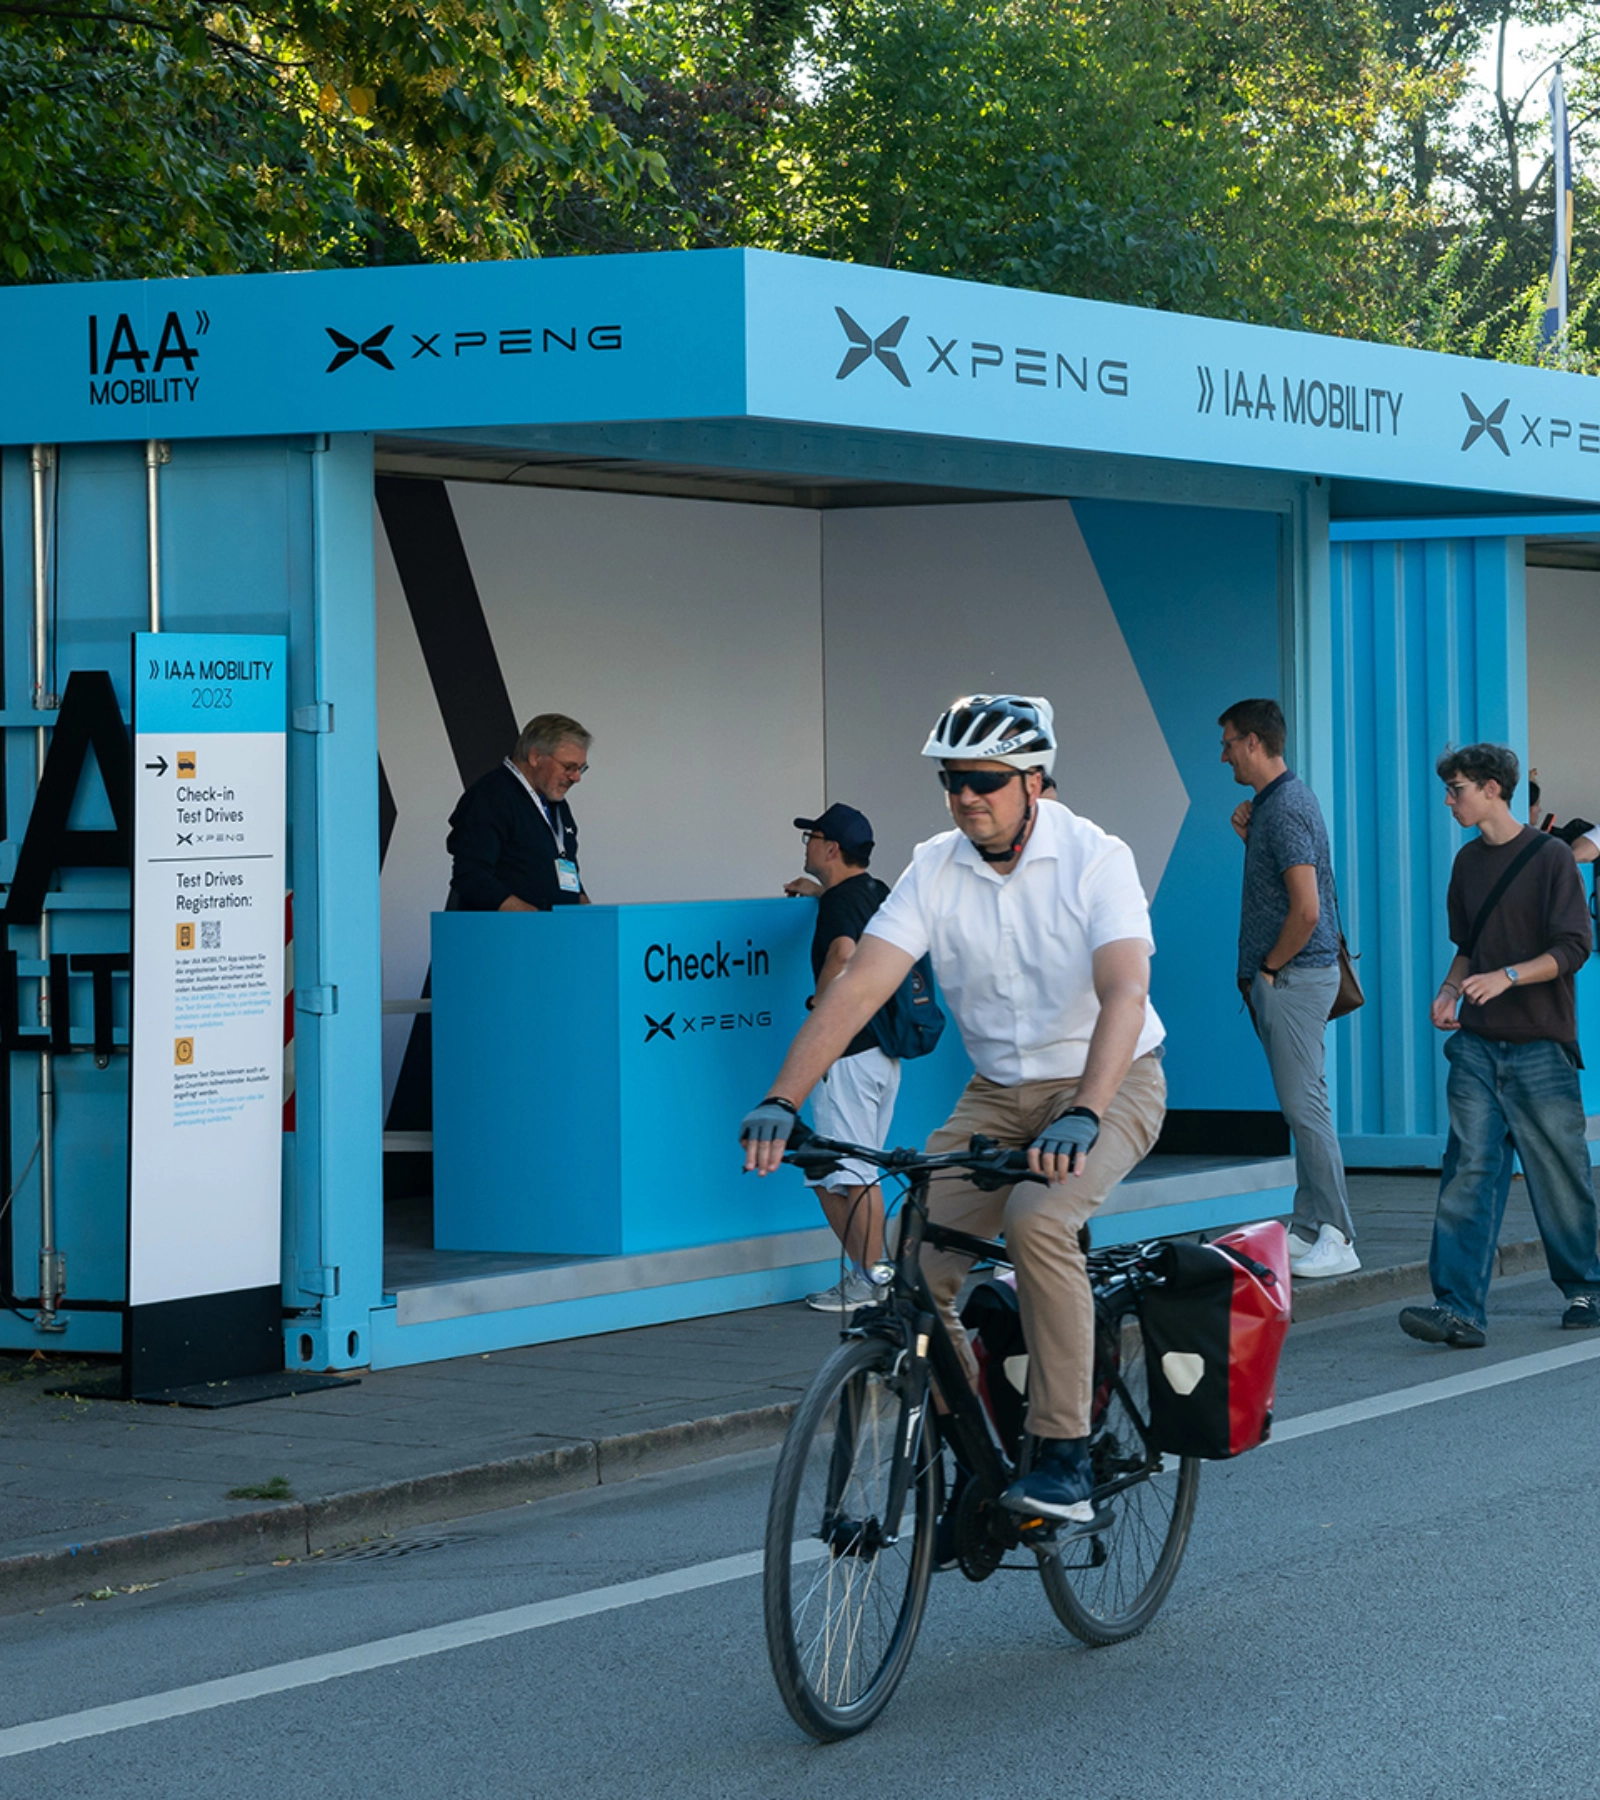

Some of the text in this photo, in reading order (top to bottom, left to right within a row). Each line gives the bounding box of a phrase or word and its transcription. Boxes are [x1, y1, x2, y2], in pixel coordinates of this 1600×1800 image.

[89, 312, 199, 375] IAA
[411, 325, 622, 359] XPENG
[927, 336, 1129, 397] XPENG
[90, 377, 199, 405] MOBILITY
[1225, 369, 1404, 437] IAA MOBILITY
[165, 660, 274, 681] IAA MOBILITY
[191, 688, 233, 709] 2023
[177, 786, 235, 803] Check-in
[177, 807, 244, 825] Test Drives
[196, 833, 245, 843] XPENG
[176, 871, 243, 888] Test Drives
[176, 893, 252, 914] Registration:
[644, 939, 769, 982] Check-in
[682, 1011, 772, 1033] XPENG
